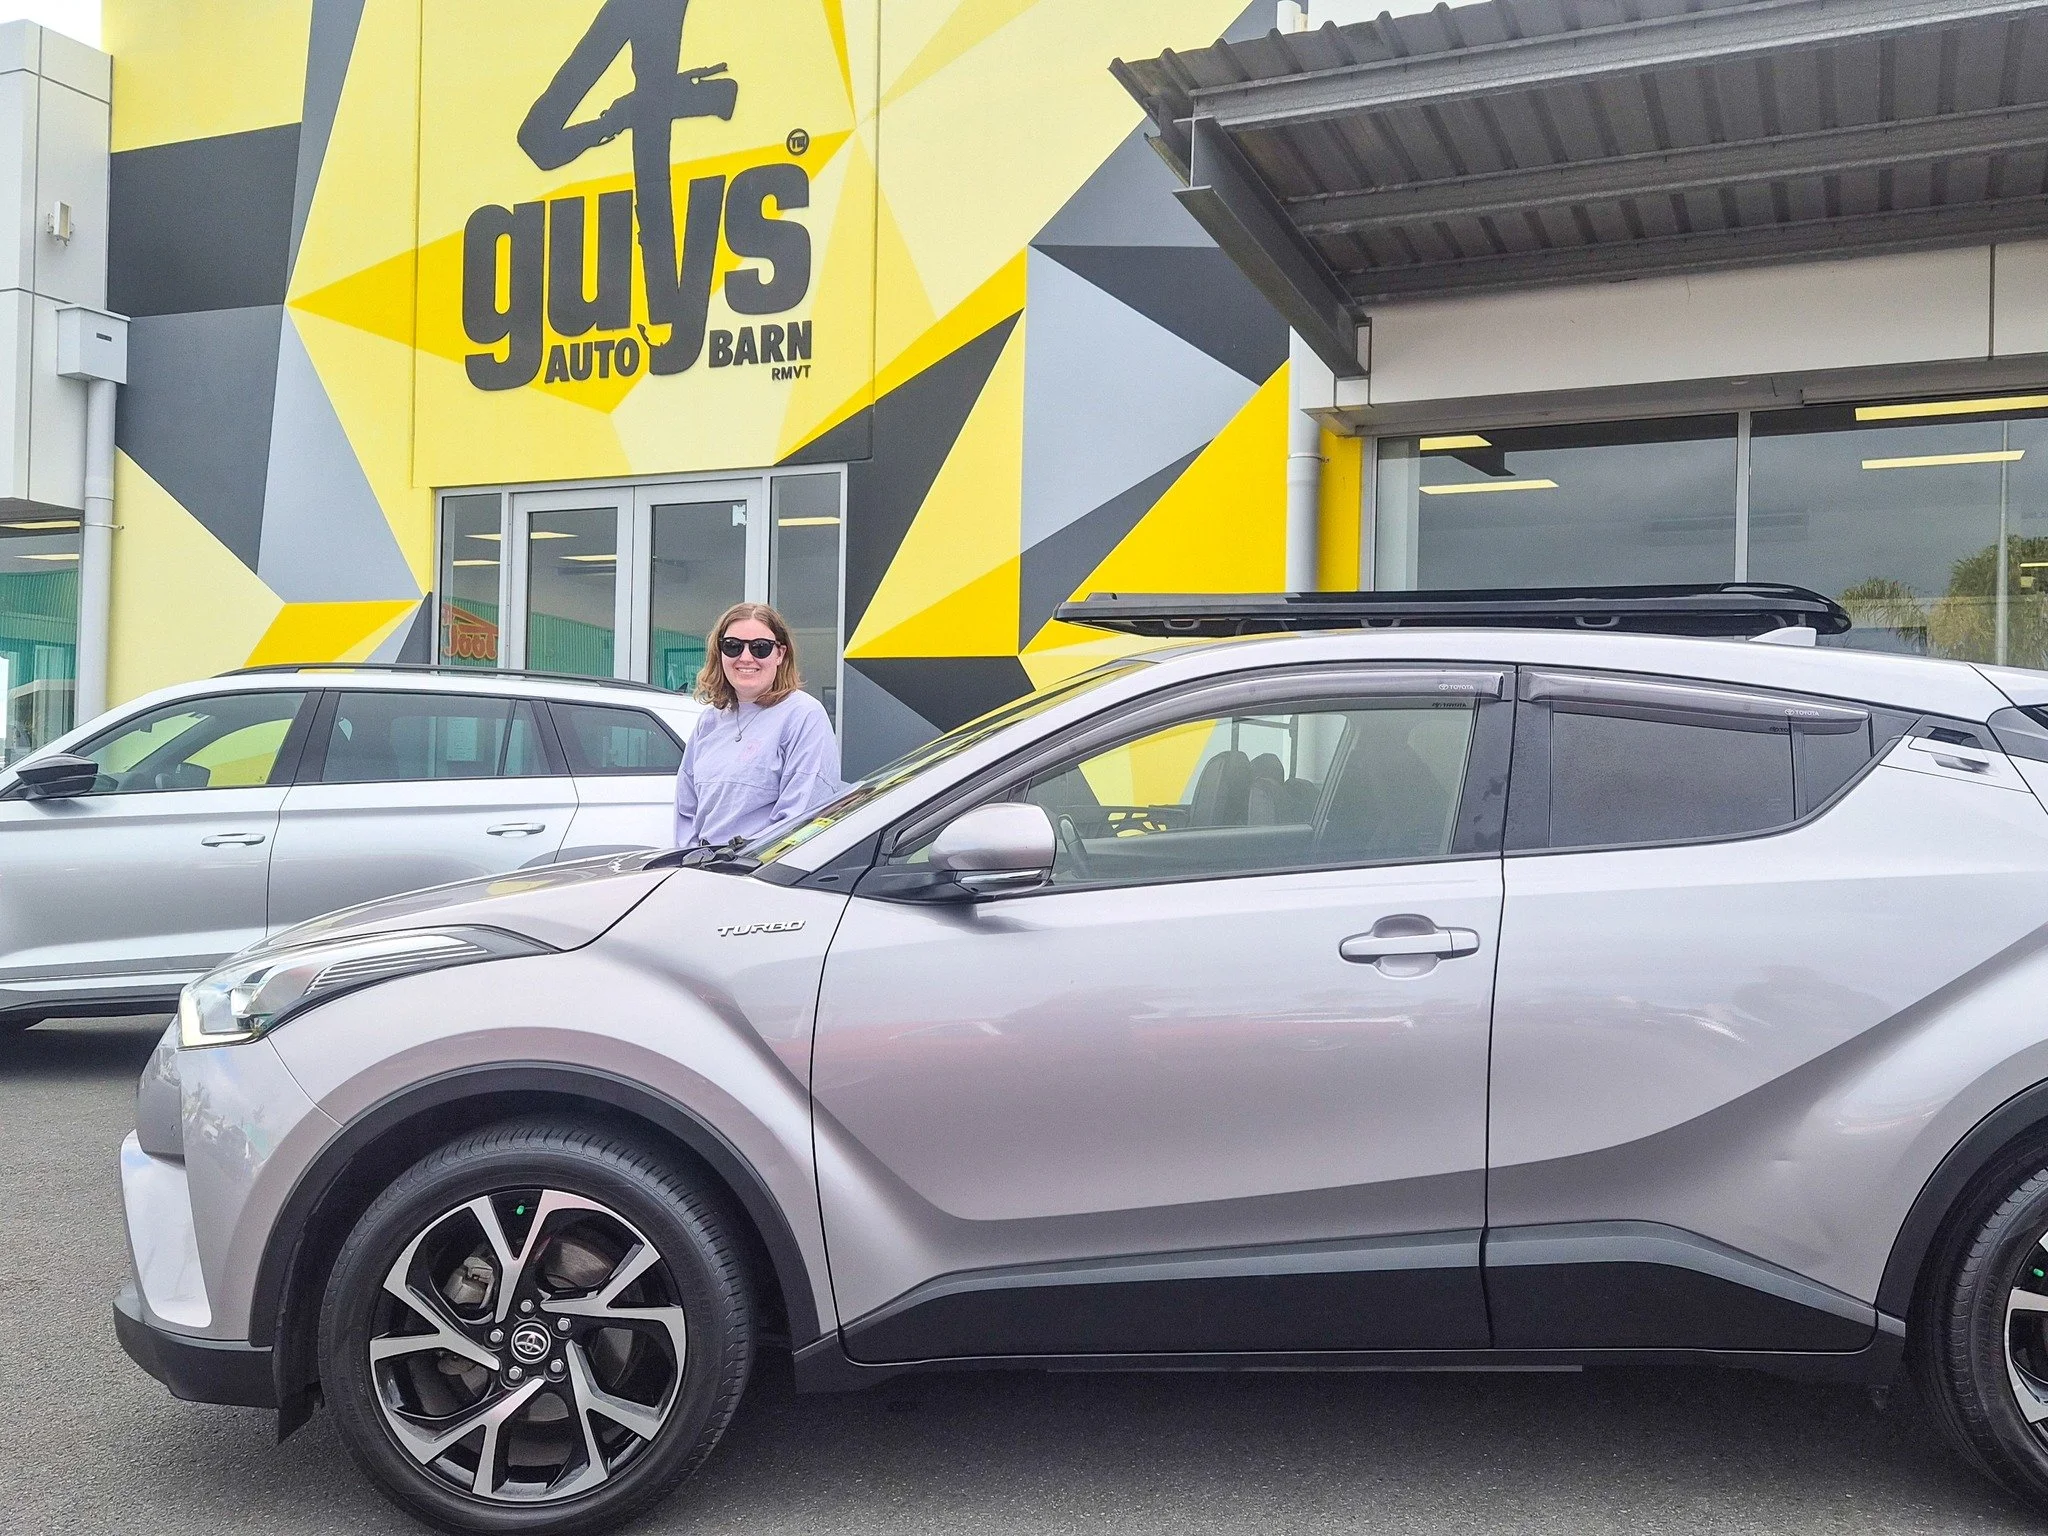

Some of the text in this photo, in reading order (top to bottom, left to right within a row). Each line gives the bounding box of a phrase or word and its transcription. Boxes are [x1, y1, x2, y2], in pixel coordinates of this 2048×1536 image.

[517, 0, 738, 250] 4
[462, 163, 811, 391] guys
[545, 320, 812, 383] AUTO BARN
[771, 365, 811, 382] RMVT
[717, 919, 806, 937] TURBO
